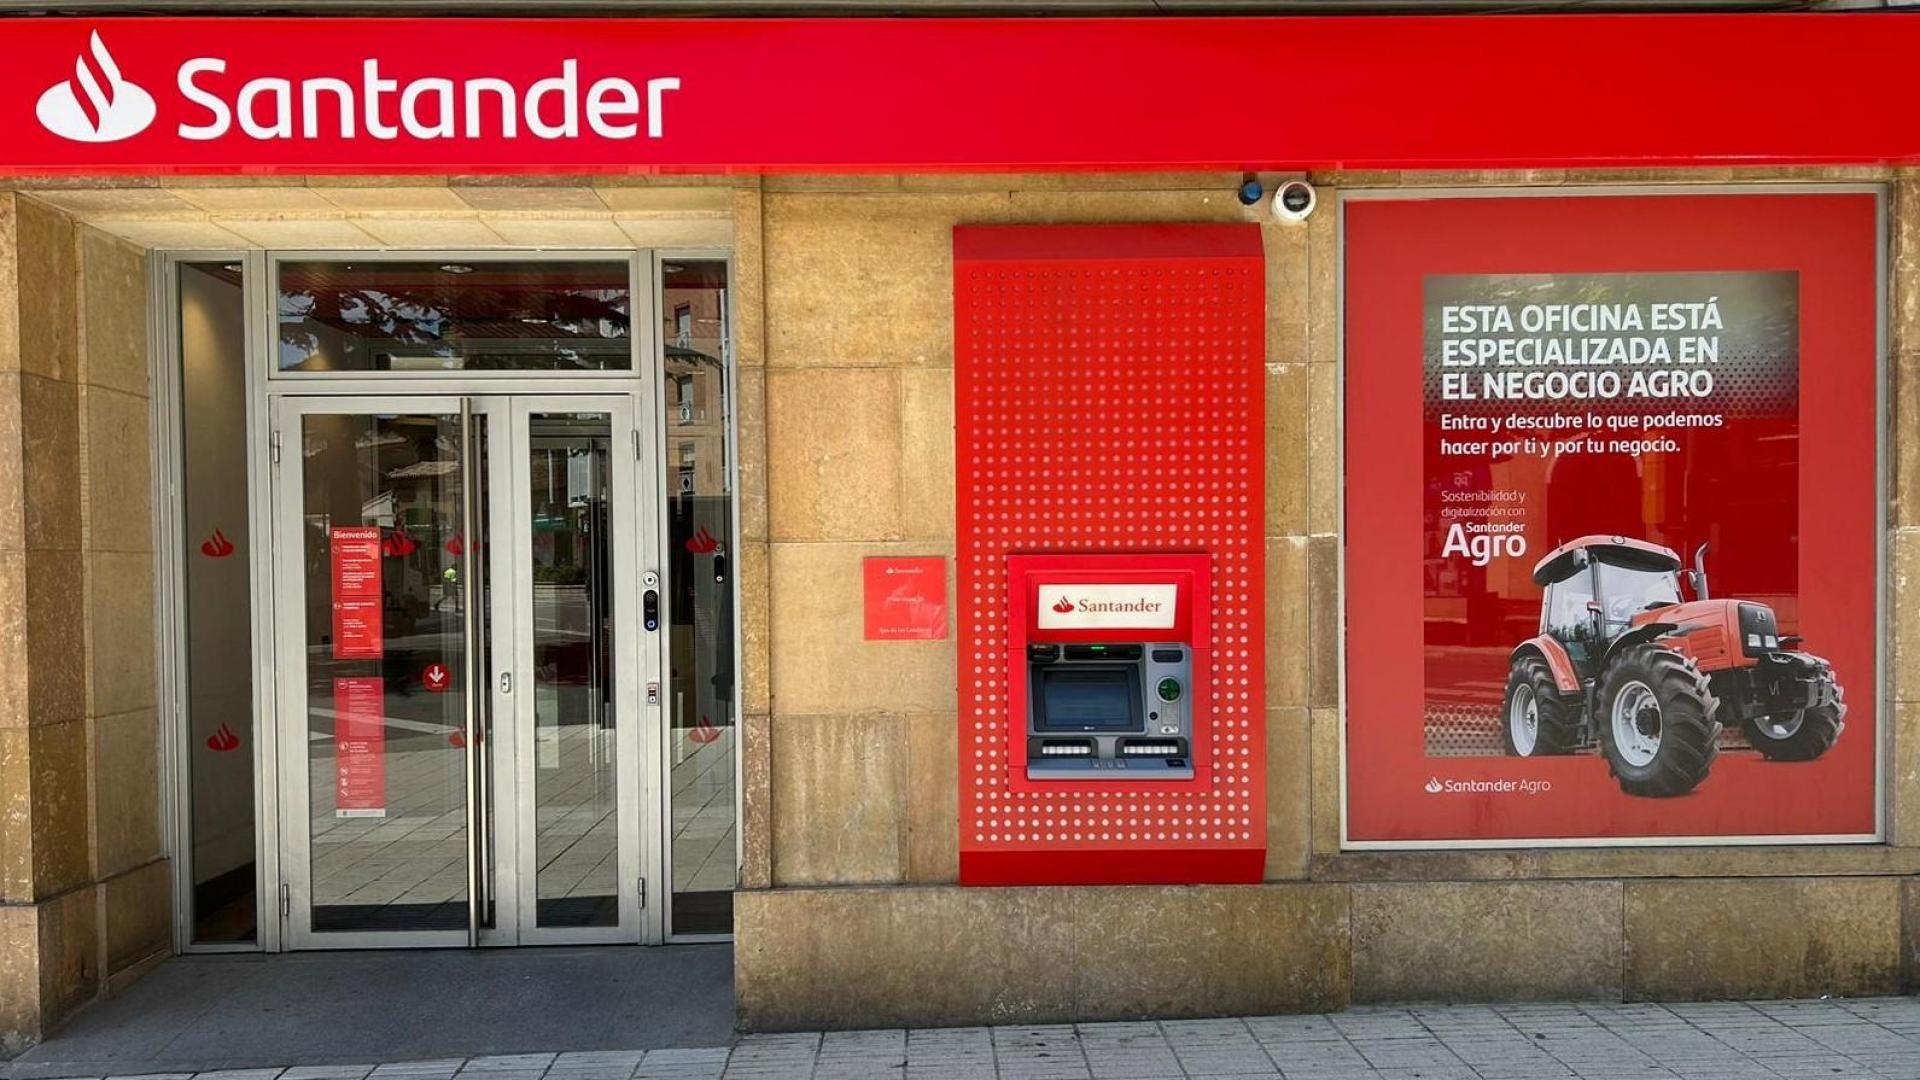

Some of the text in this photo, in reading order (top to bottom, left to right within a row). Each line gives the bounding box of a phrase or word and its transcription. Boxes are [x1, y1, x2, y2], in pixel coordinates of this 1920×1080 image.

[177, 57, 681, 140] Santander
[1441, 296, 1723, 333] ESTA OFICINA ESTÁ
[1441, 336, 1719, 366] ESPECIALIZADA EN
[1441, 369, 1713, 400] EL NEGOCIO AGRO
[1441, 412, 1723, 434] Entra y descubre lo que podemos
[1441, 436, 1681, 458] hacer por ti y por tu negocio.
[1441, 490, 1526, 504] Sostenibilidad y
[1507, 508, 1525, 516] con
[333, 530, 378, 539] Bienvenido
[1466, 522, 1525, 533] Santander
[1441, 523, 1526, 566] Agro
[1078, 598, 1162, 613] Santander
[1445, 778, 1551, 794] Santander Agro
